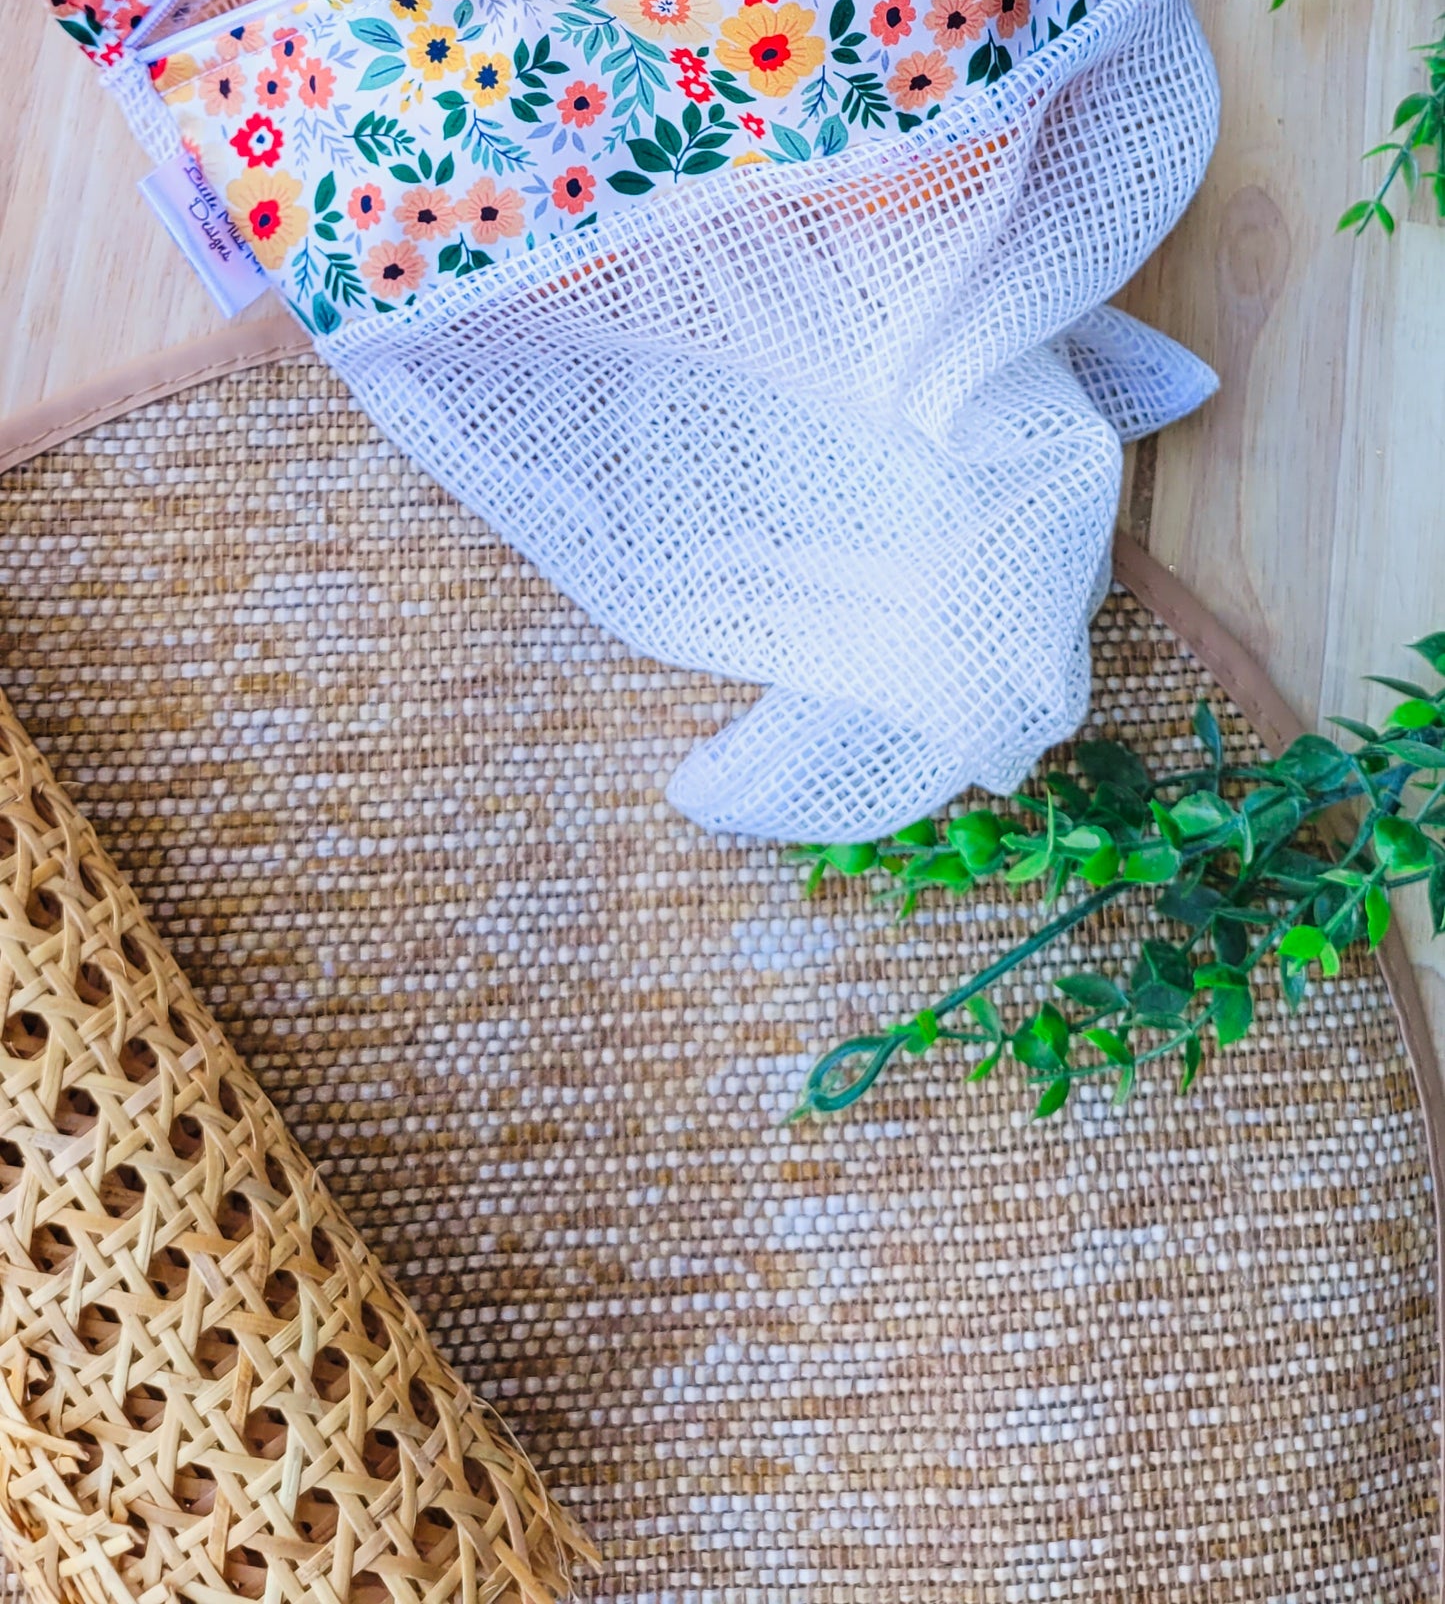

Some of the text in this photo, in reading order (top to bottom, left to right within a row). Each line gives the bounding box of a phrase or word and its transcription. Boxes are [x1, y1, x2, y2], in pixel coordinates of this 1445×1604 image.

[184, 166, 217, 211] Little
[216, 210, 246, 252] Miss
[189, 197, 232, 262] Designs
